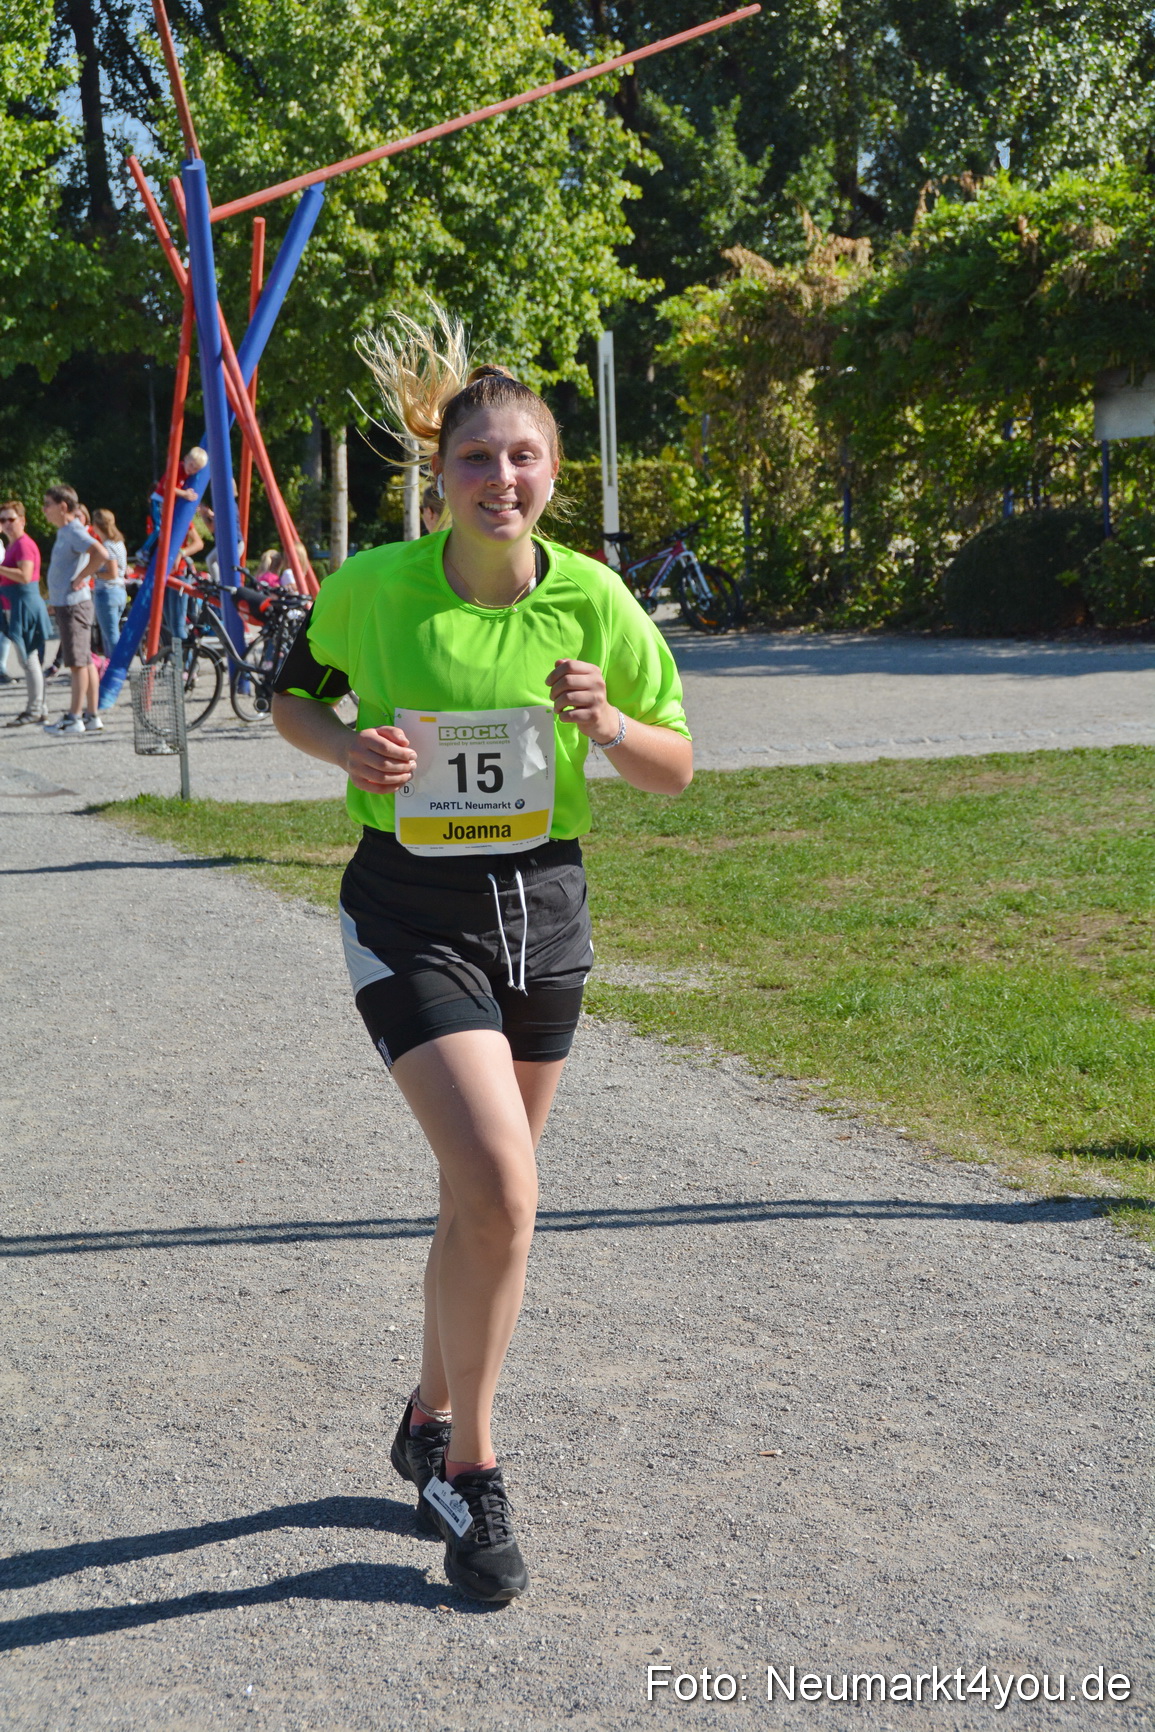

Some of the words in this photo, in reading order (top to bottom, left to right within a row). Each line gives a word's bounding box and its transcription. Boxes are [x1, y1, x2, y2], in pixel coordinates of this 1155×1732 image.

[438, 724, 509, 741] BOCK
[448, 752, 504, 794] 15
[404, 786, 410, 794] D
[429, 801, 463, 811] PARTL
[465, 800, 512, 810] Neumarkt
[443, 821, 512, 841] Joanna
